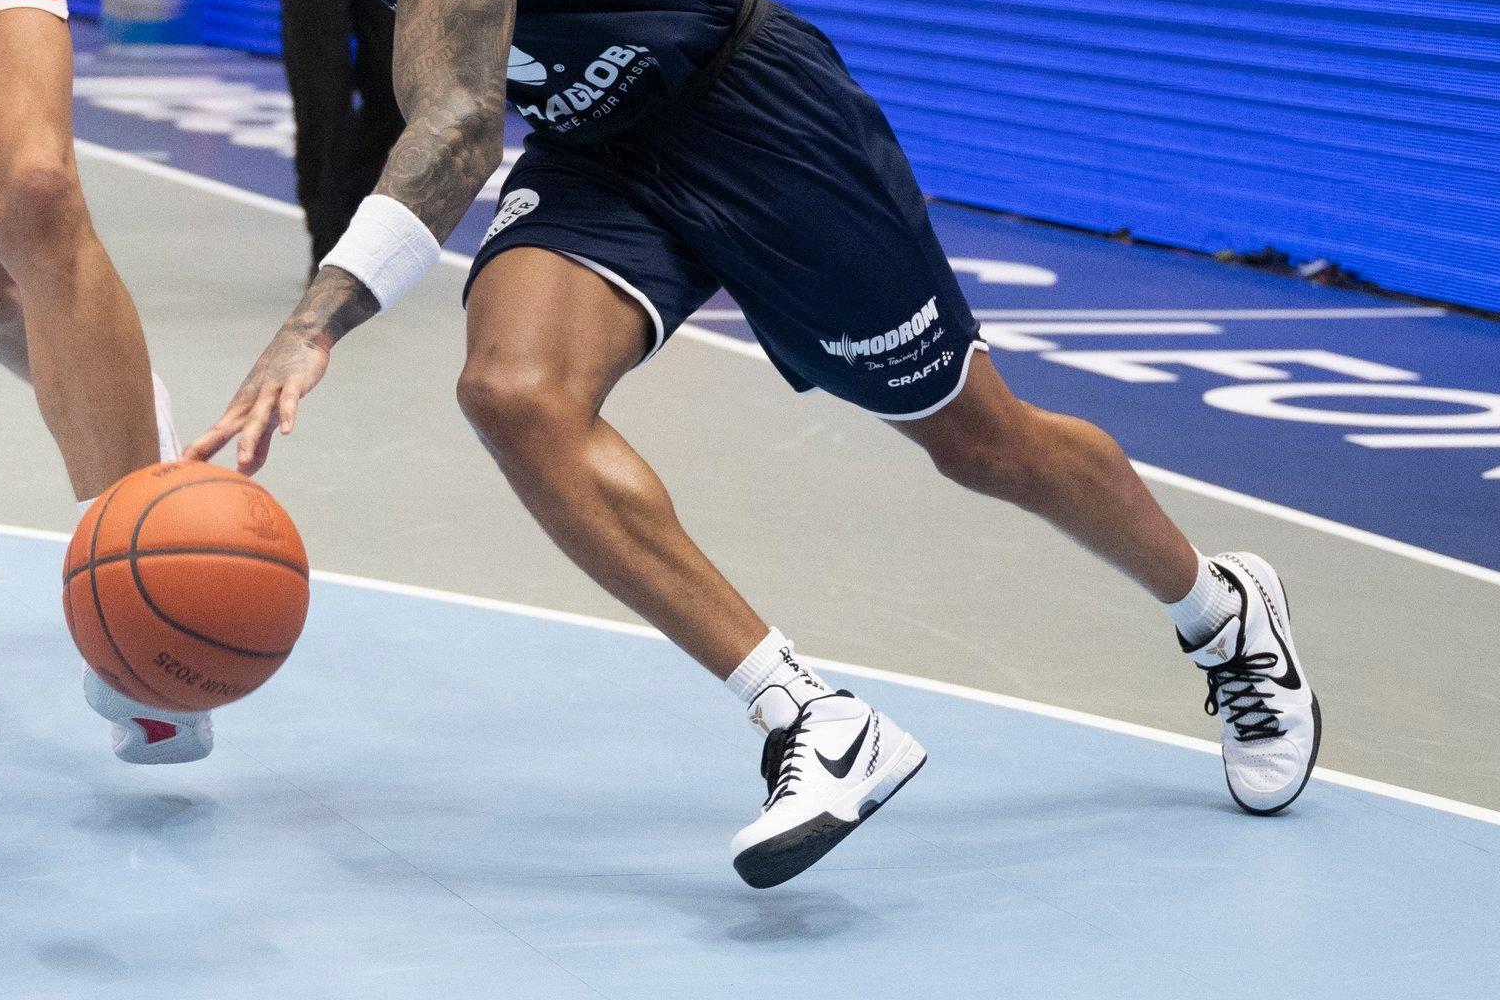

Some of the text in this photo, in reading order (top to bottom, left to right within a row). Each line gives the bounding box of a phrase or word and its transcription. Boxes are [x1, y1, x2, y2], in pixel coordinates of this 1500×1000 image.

[592, 95, 620, 119] OUR
[819, 298, 938, 358] VIMODROM
[864, 360, 885, 371] Das
[886, 350, 919, 367] Training
[887, 358, 941, 387] CRAFT
